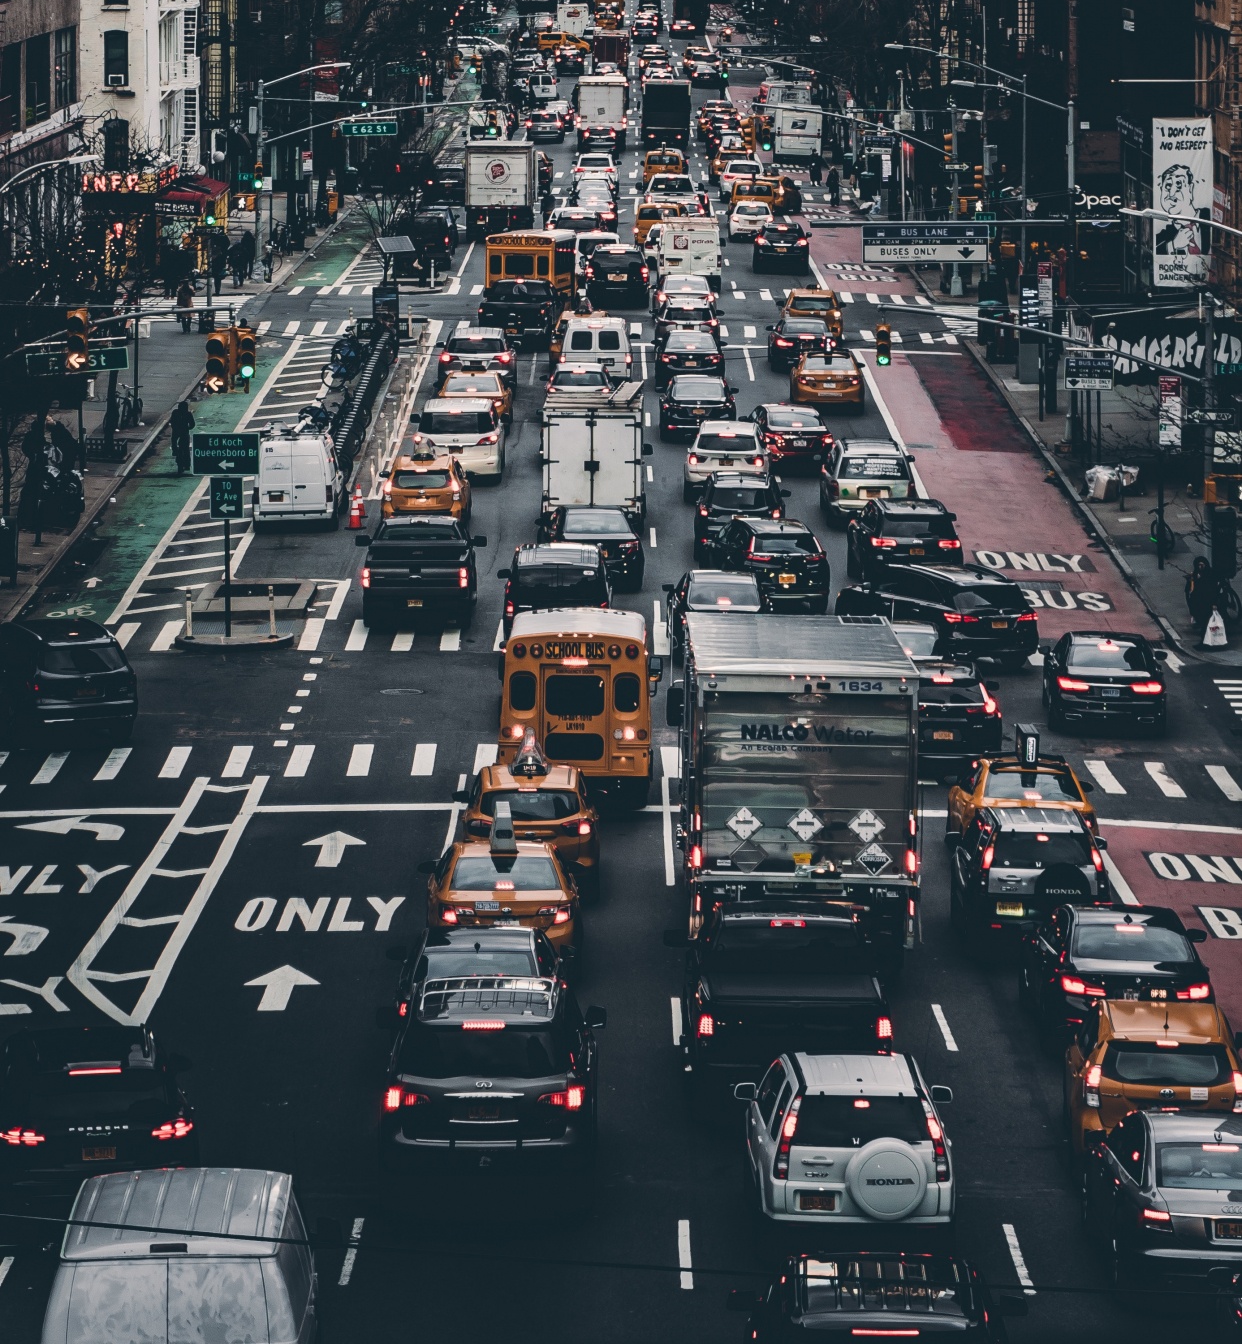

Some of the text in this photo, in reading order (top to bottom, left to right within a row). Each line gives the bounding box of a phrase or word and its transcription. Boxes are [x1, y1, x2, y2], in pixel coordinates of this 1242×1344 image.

[352, 125, 387, 134] E 62 St
[1168, 125, 1191, 137] DON'T
[1192, 127, 1205, 137] GET
[1160, 141, 1173, 151] NO
[901, 228, 948, 236] BUS LANE
[503, 237, 536, 246] SCHOOL BUS
[880, 248, 937, 256] BUSES ONLY
[826, 263, 895, 273] ONLY
[1159, 264, 1188, 272] RODNEY
[838, 273, 898, 283] BUS
[88, 354, 107, 367] St
[209, 438, 243, 446] Ed Koch
[194, 449, 257, 457] Queensboro Br
[221, 481, 232, 490] TO
[216, 492, 238, 501] 2 Ave
[975, 550, 1084, 573] ONLY
[1020, 588, 1111, 612] BUS
[546, 641, 605, 658] SCHOOL BUS
[838, 681, 883, 692] 1634
[741, 724, 874, 743] NALCO Water
[791, 745, 833, 754] Company
[1149, 852, 1242, 885] ON
[234, 897, 406, 932] ONLY
[68, 1124, 129, 1132] PORSCHE
[866, 1178, 915, 1186] HONDA
